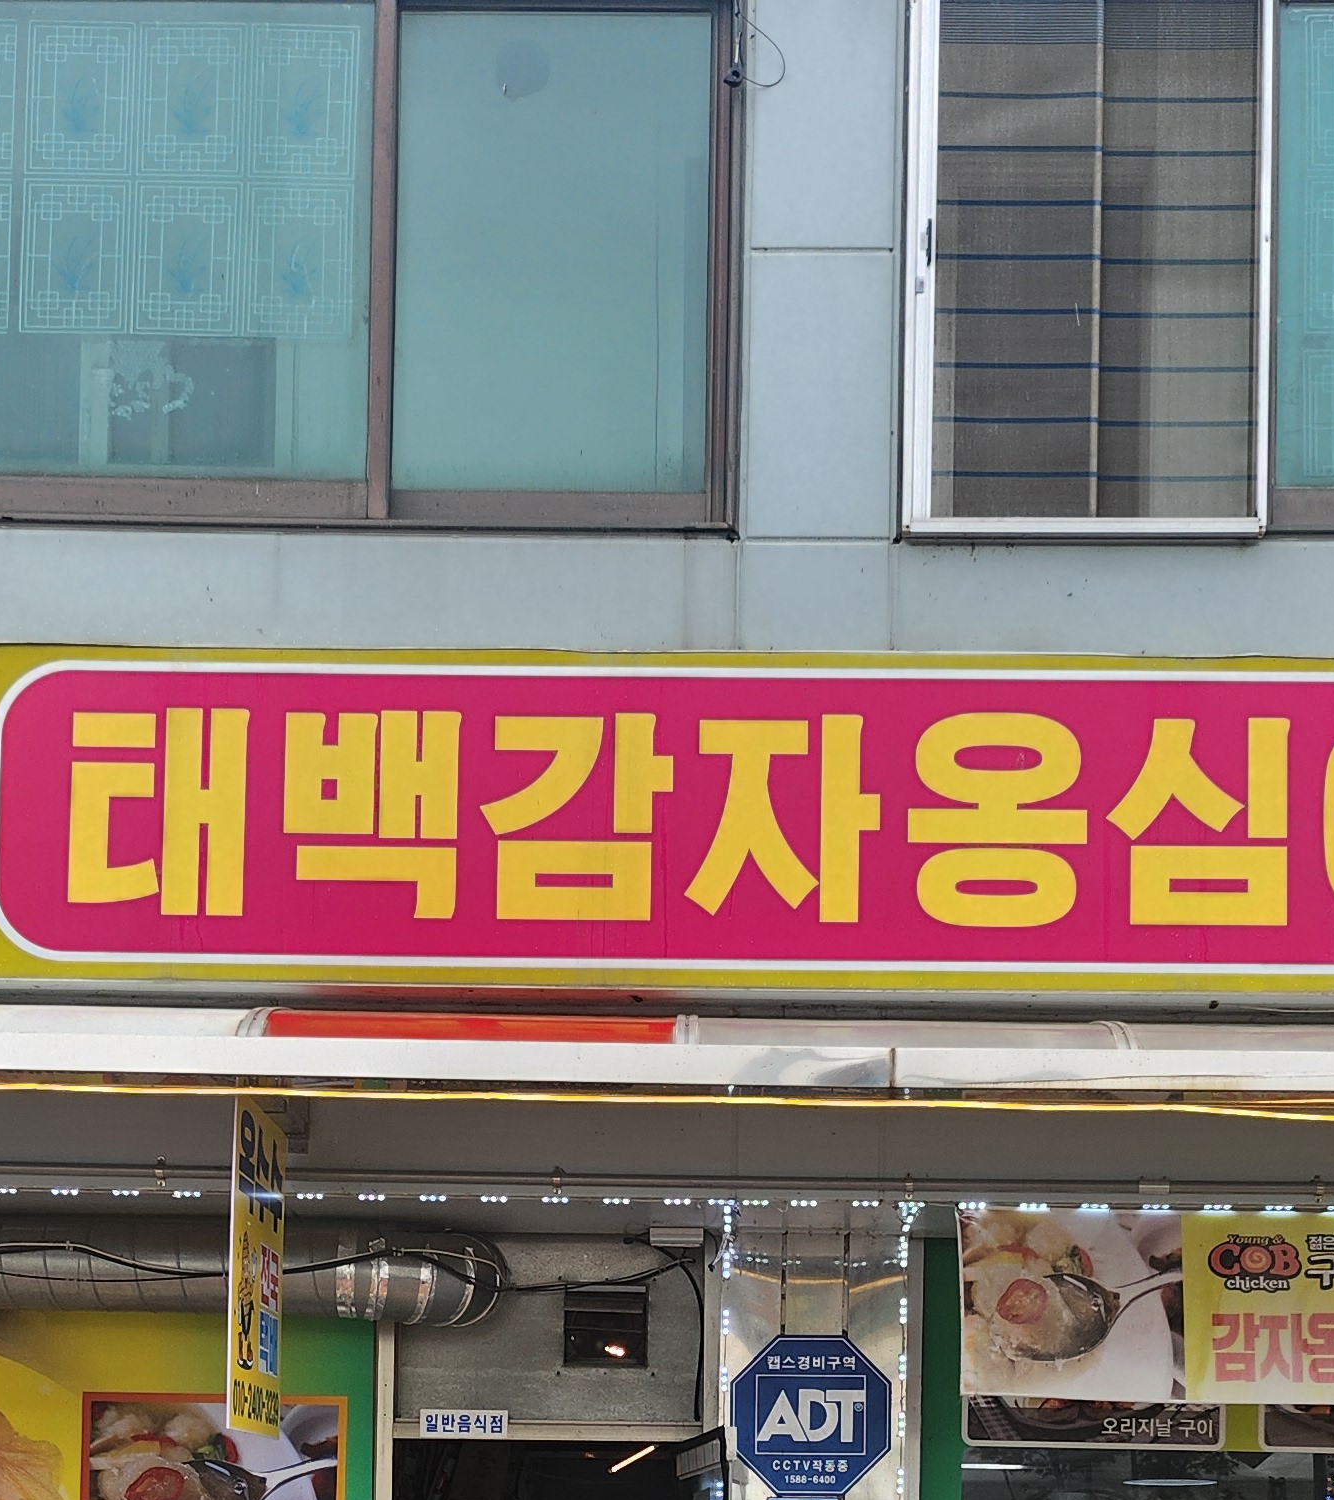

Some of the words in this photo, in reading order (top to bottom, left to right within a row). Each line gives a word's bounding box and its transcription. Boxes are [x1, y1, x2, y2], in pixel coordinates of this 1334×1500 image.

[238, 1110, 283, 1234] 옥수수
[1226, 1234, 1269, 1245] Young
[1208, 1242, 1301, 1277] COB
[260, 1243, 280, 1313] 전국
[1225, 1275, 1289, 1291] chicken
[767, 1355, 857, 1371] 캡스경비구역
[424, 1413, 506, 1435] 일반음식점
[757, 1388, 865, 1443] ADT
[1101, 1417, 1173, 1439] 오리지날
[1177, 1417, 1214, 1440] 구이
[772, 1460, 849, 1473] CCTV작동중
[784, 1475, 836, 1485] 1588-6400
